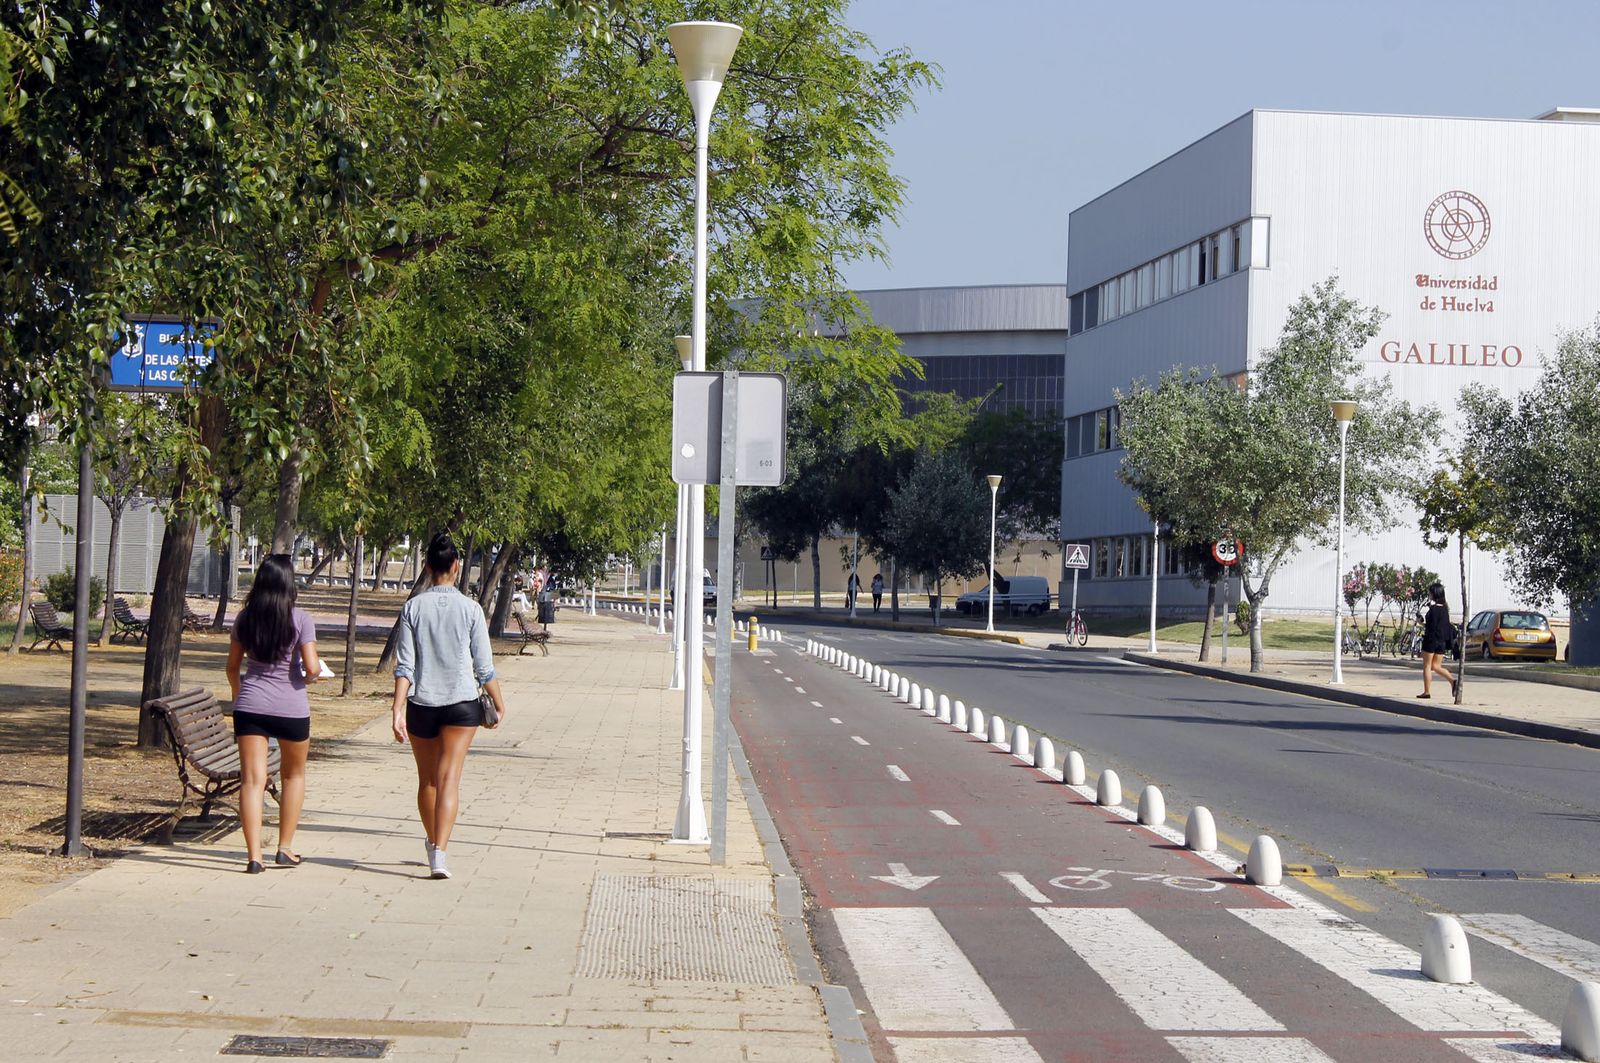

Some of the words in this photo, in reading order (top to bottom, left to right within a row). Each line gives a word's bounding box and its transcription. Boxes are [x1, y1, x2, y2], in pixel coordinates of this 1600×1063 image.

[1415, 274, 1498, 290] Universidad
[1420, 296, 1436, 310] de
[1441, 296, 1494, 312] Huelva
[145, 354, 158, 365] DE
[160, 354, 179, 365] LAS
[1380, 340, 1523, 367] GALILEO
[149, 370, 167, 381] LAS
